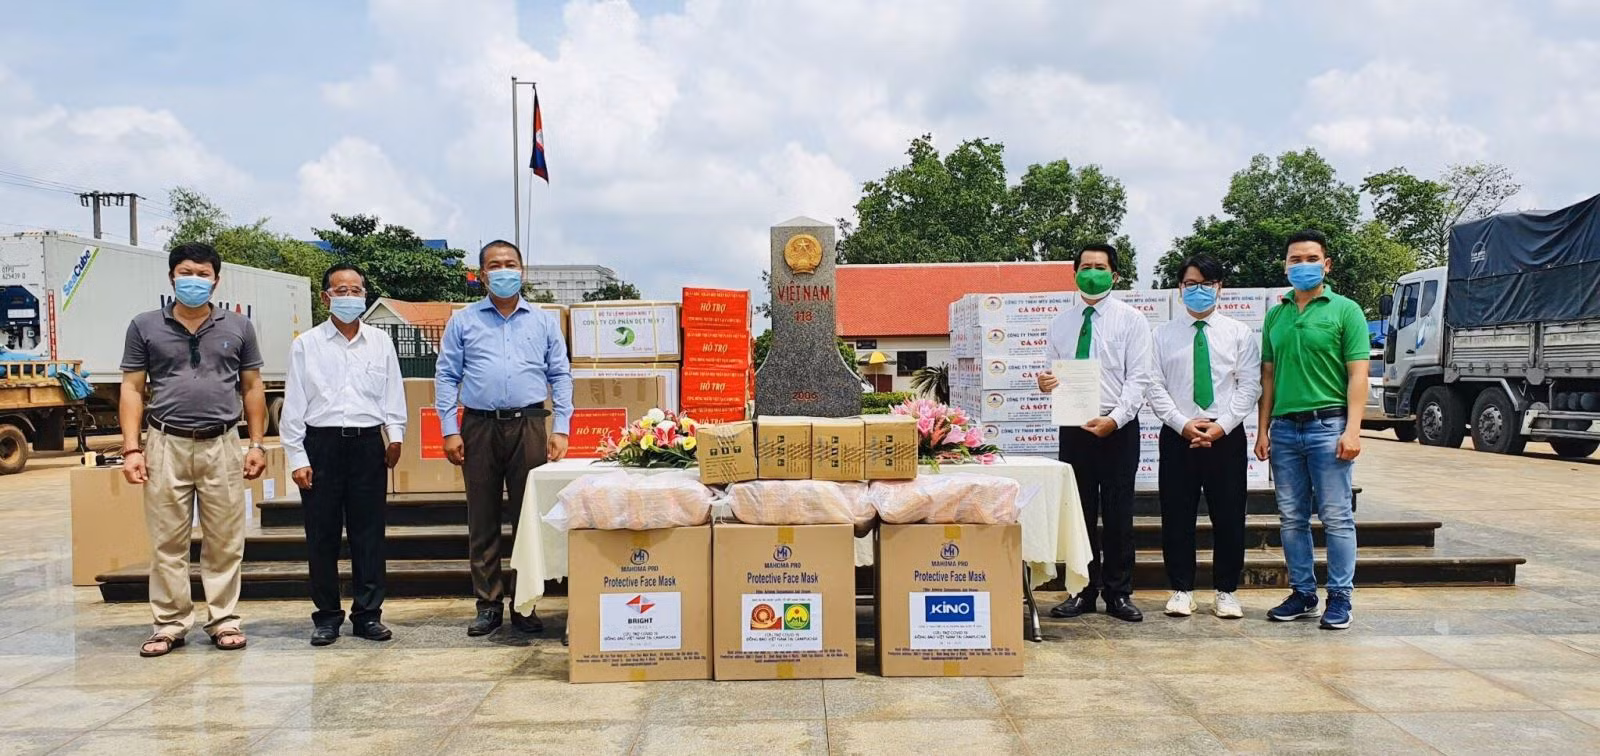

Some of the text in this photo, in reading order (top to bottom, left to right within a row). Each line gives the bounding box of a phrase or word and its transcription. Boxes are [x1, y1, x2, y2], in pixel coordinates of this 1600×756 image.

[63, 249, 91, 296] SeaCube
[778, 280, 830, 305] VIỆT NAM
[712, 303, 726, 314] TRỢ
[795, 311, 813, 321] 118
[714, 344, 728, 354] TRỢ
[712, 383, 726, 393] TRỢ
[604, 576, 676, 587] Protective Face Mask
[747, 572, 818, 583] Protective Face Mask
[914, 570, 986, 582] Protective Face Mask
